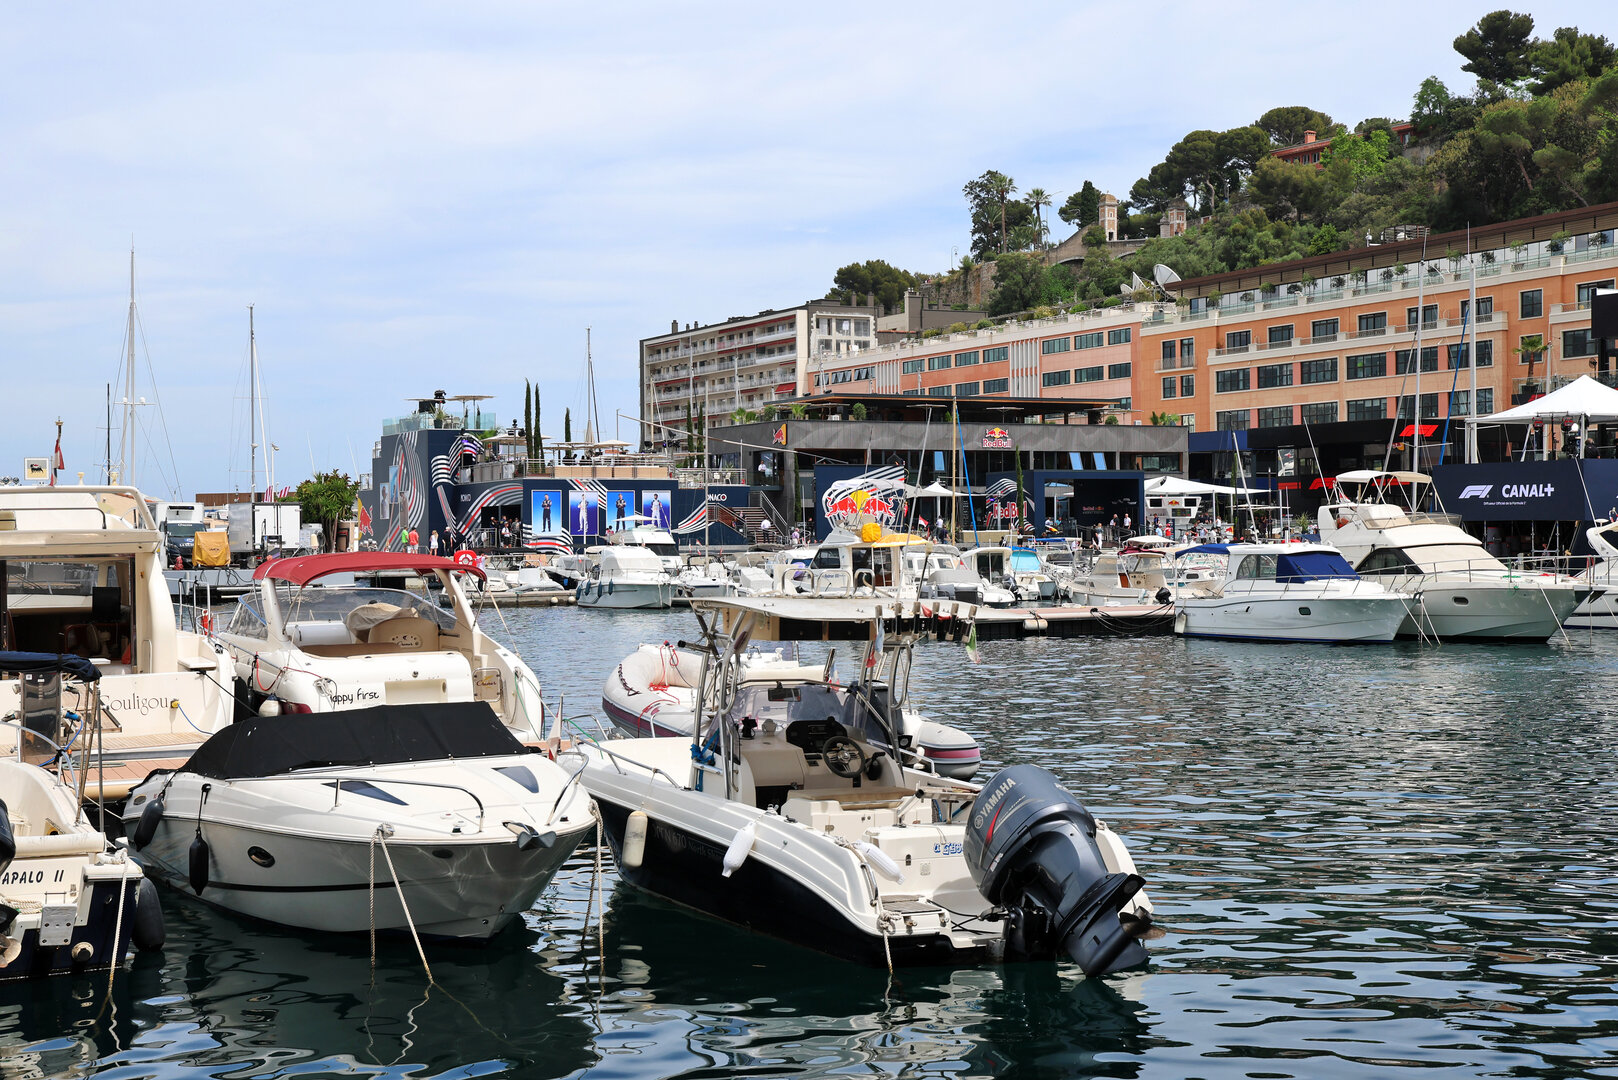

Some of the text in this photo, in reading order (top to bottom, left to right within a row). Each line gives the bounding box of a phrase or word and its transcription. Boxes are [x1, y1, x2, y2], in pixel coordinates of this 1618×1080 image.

[1458, 483, 1555, 499] F1 CANAL+
[993, 500, 1028, 519] Red Bl
[100, 693, 168, 715] ouligou
[980, 777, 1017, 817] YAMAHA
